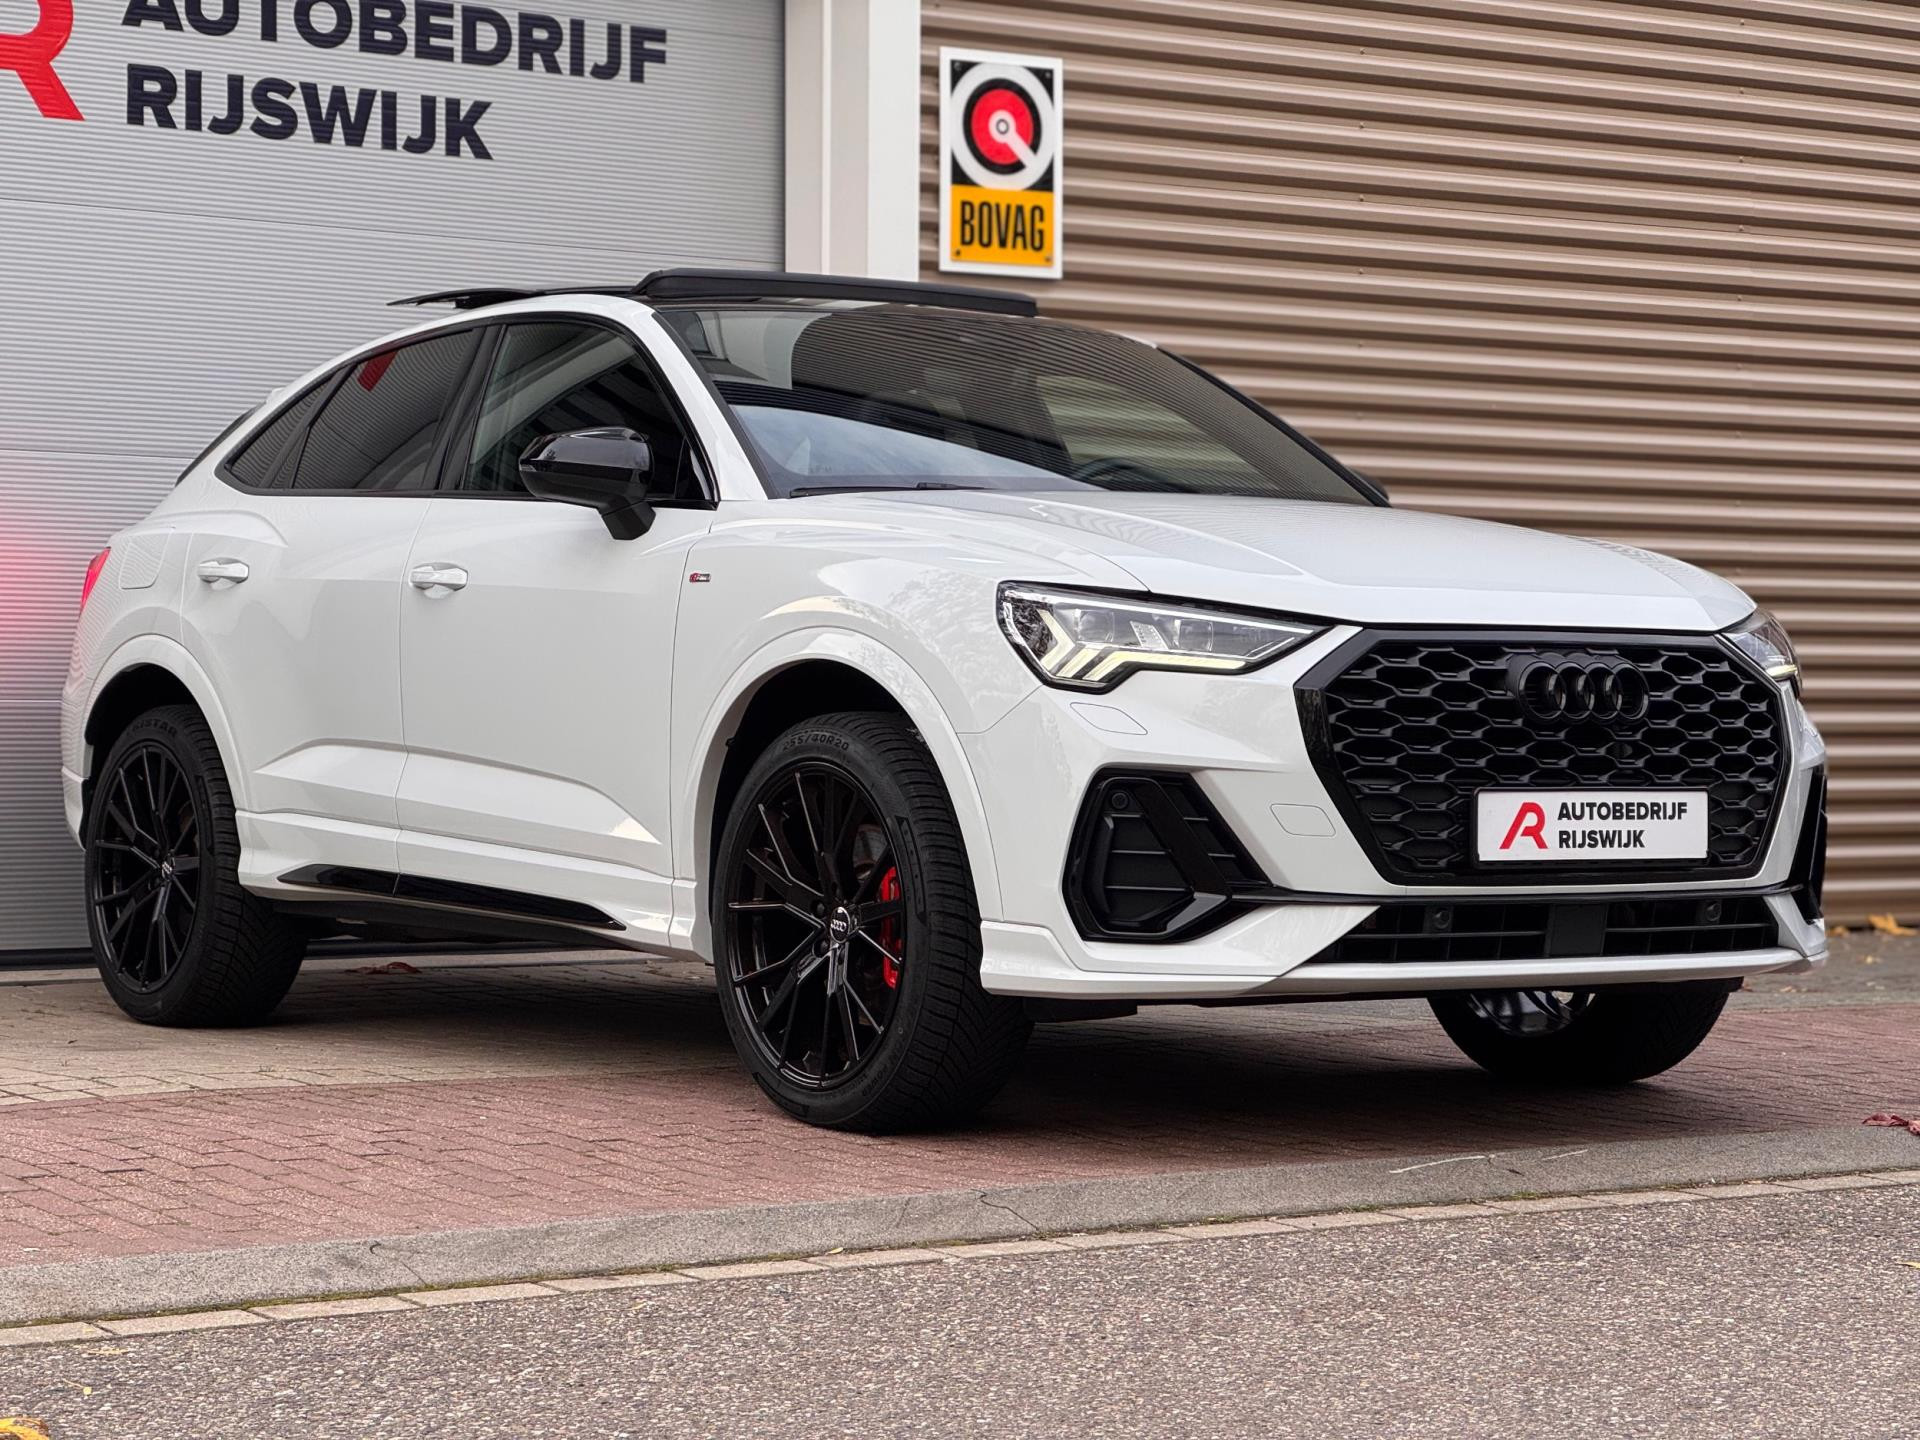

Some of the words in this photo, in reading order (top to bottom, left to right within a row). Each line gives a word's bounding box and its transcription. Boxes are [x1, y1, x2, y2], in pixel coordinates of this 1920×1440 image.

[126, 63, 493, 160] RIJSWIJK
[960, 200, 1044, 252] BOVAG
[783, 733, 849, 751] 255/40R20
[1557, 801, 1688, 821] AUTOBEDRIJF
[1558, 829, 1646, 849] RIJSWIJK
